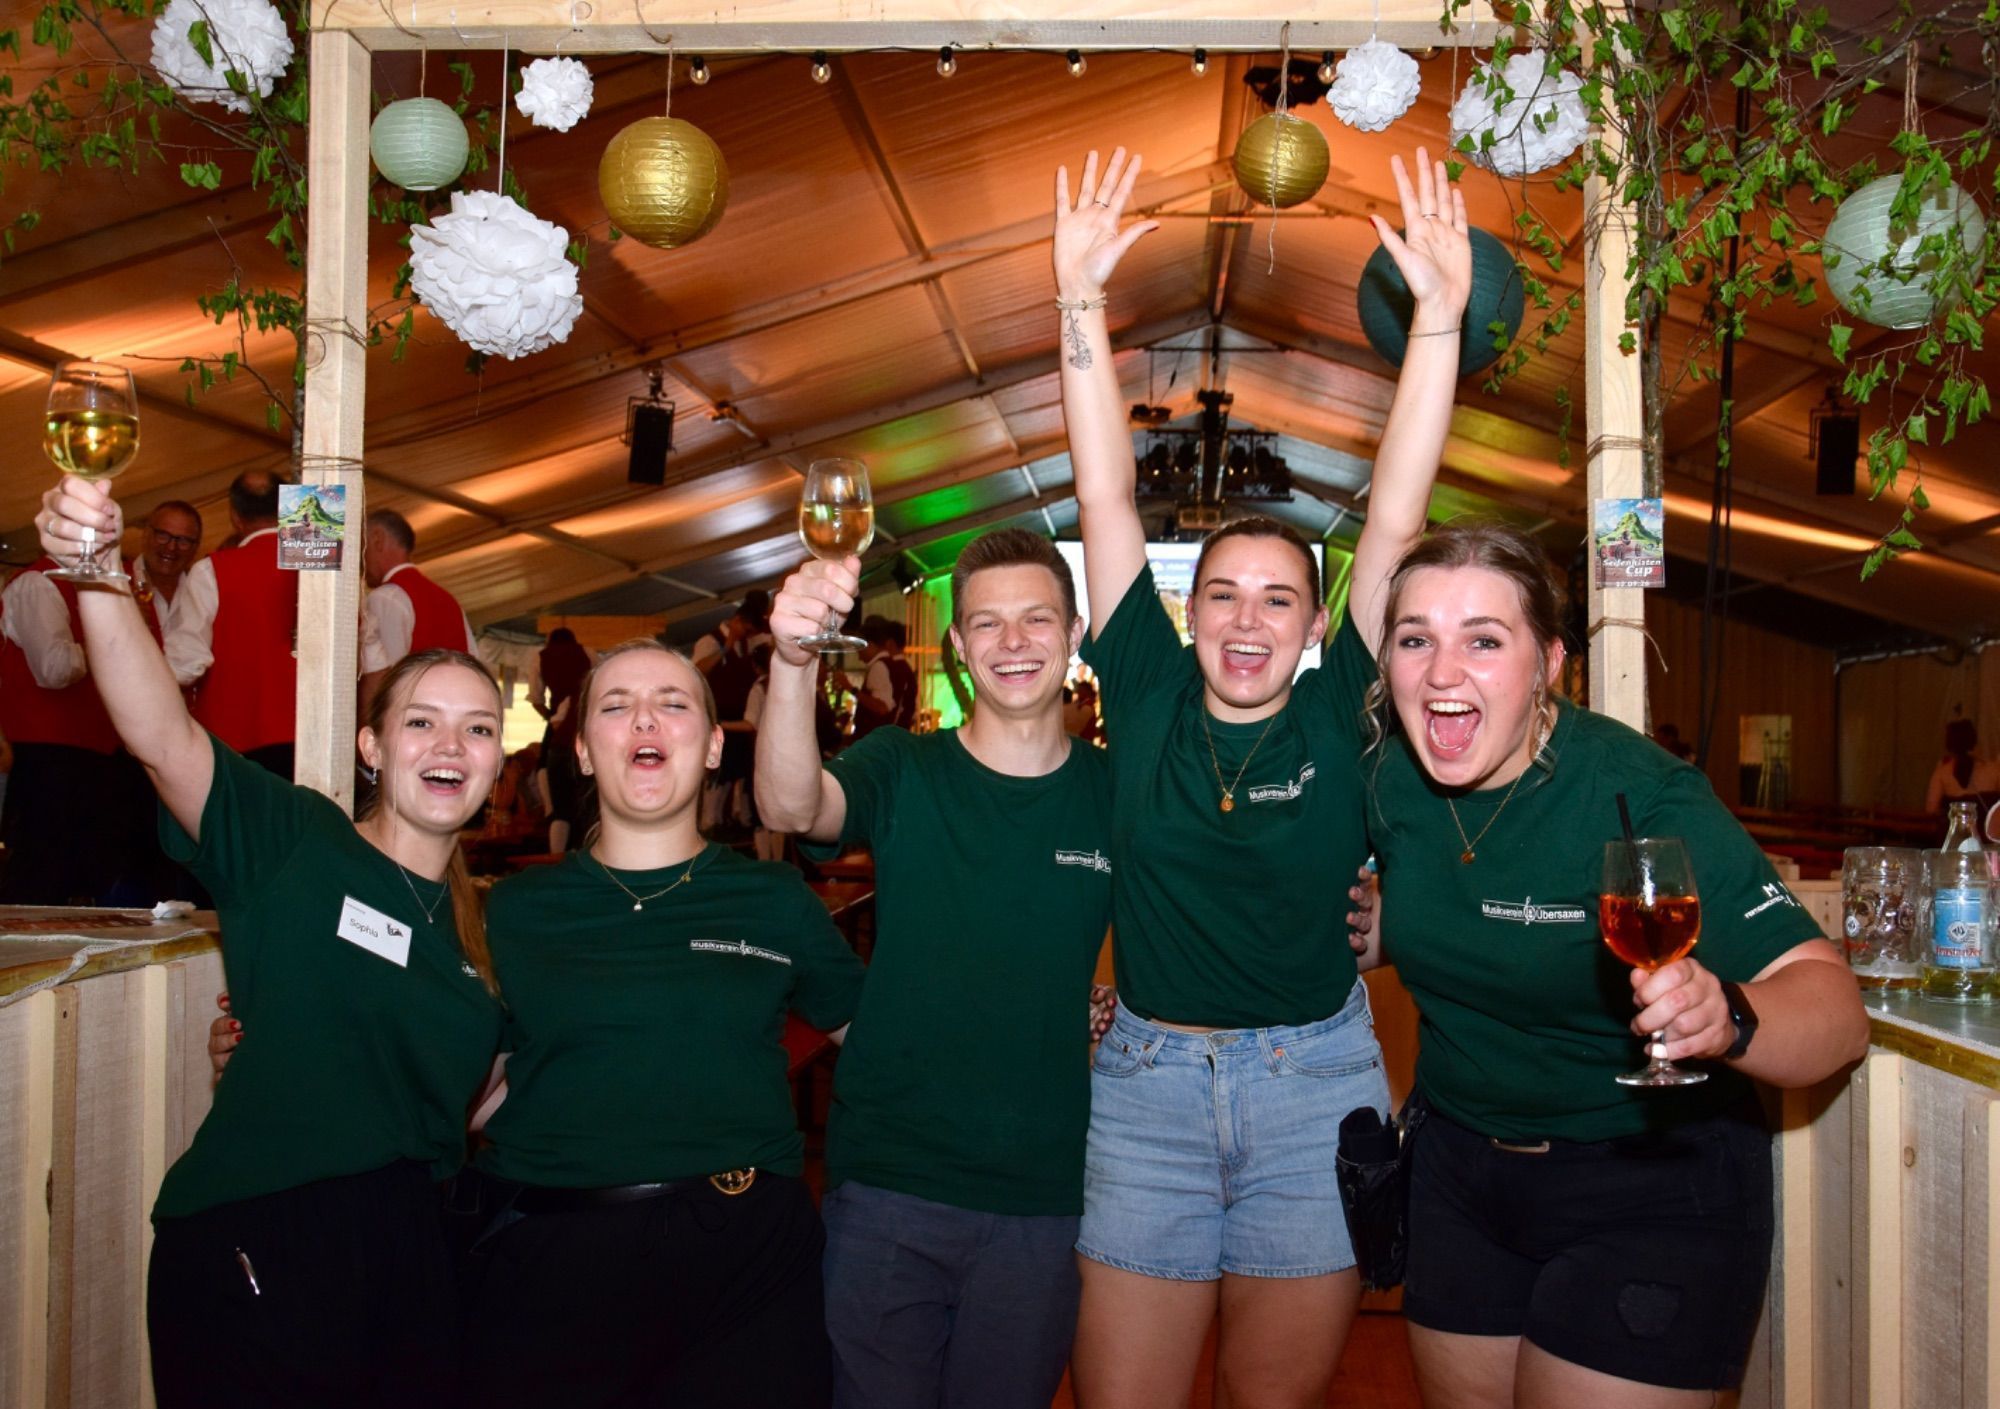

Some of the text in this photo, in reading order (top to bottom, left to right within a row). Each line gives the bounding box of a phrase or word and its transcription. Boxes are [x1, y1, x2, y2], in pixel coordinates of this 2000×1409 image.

[282, 540, 338, 549] Seifenkisten
[304, 547, 330, 559] Cup
[1602, 559, 1661, 567] Seifenkisten
[1625, 565, 1653, 577] Cup
[1481, 903, 1586, 920] Musikverein Übersaxen
[349, 917, 380, 938] Sophia
